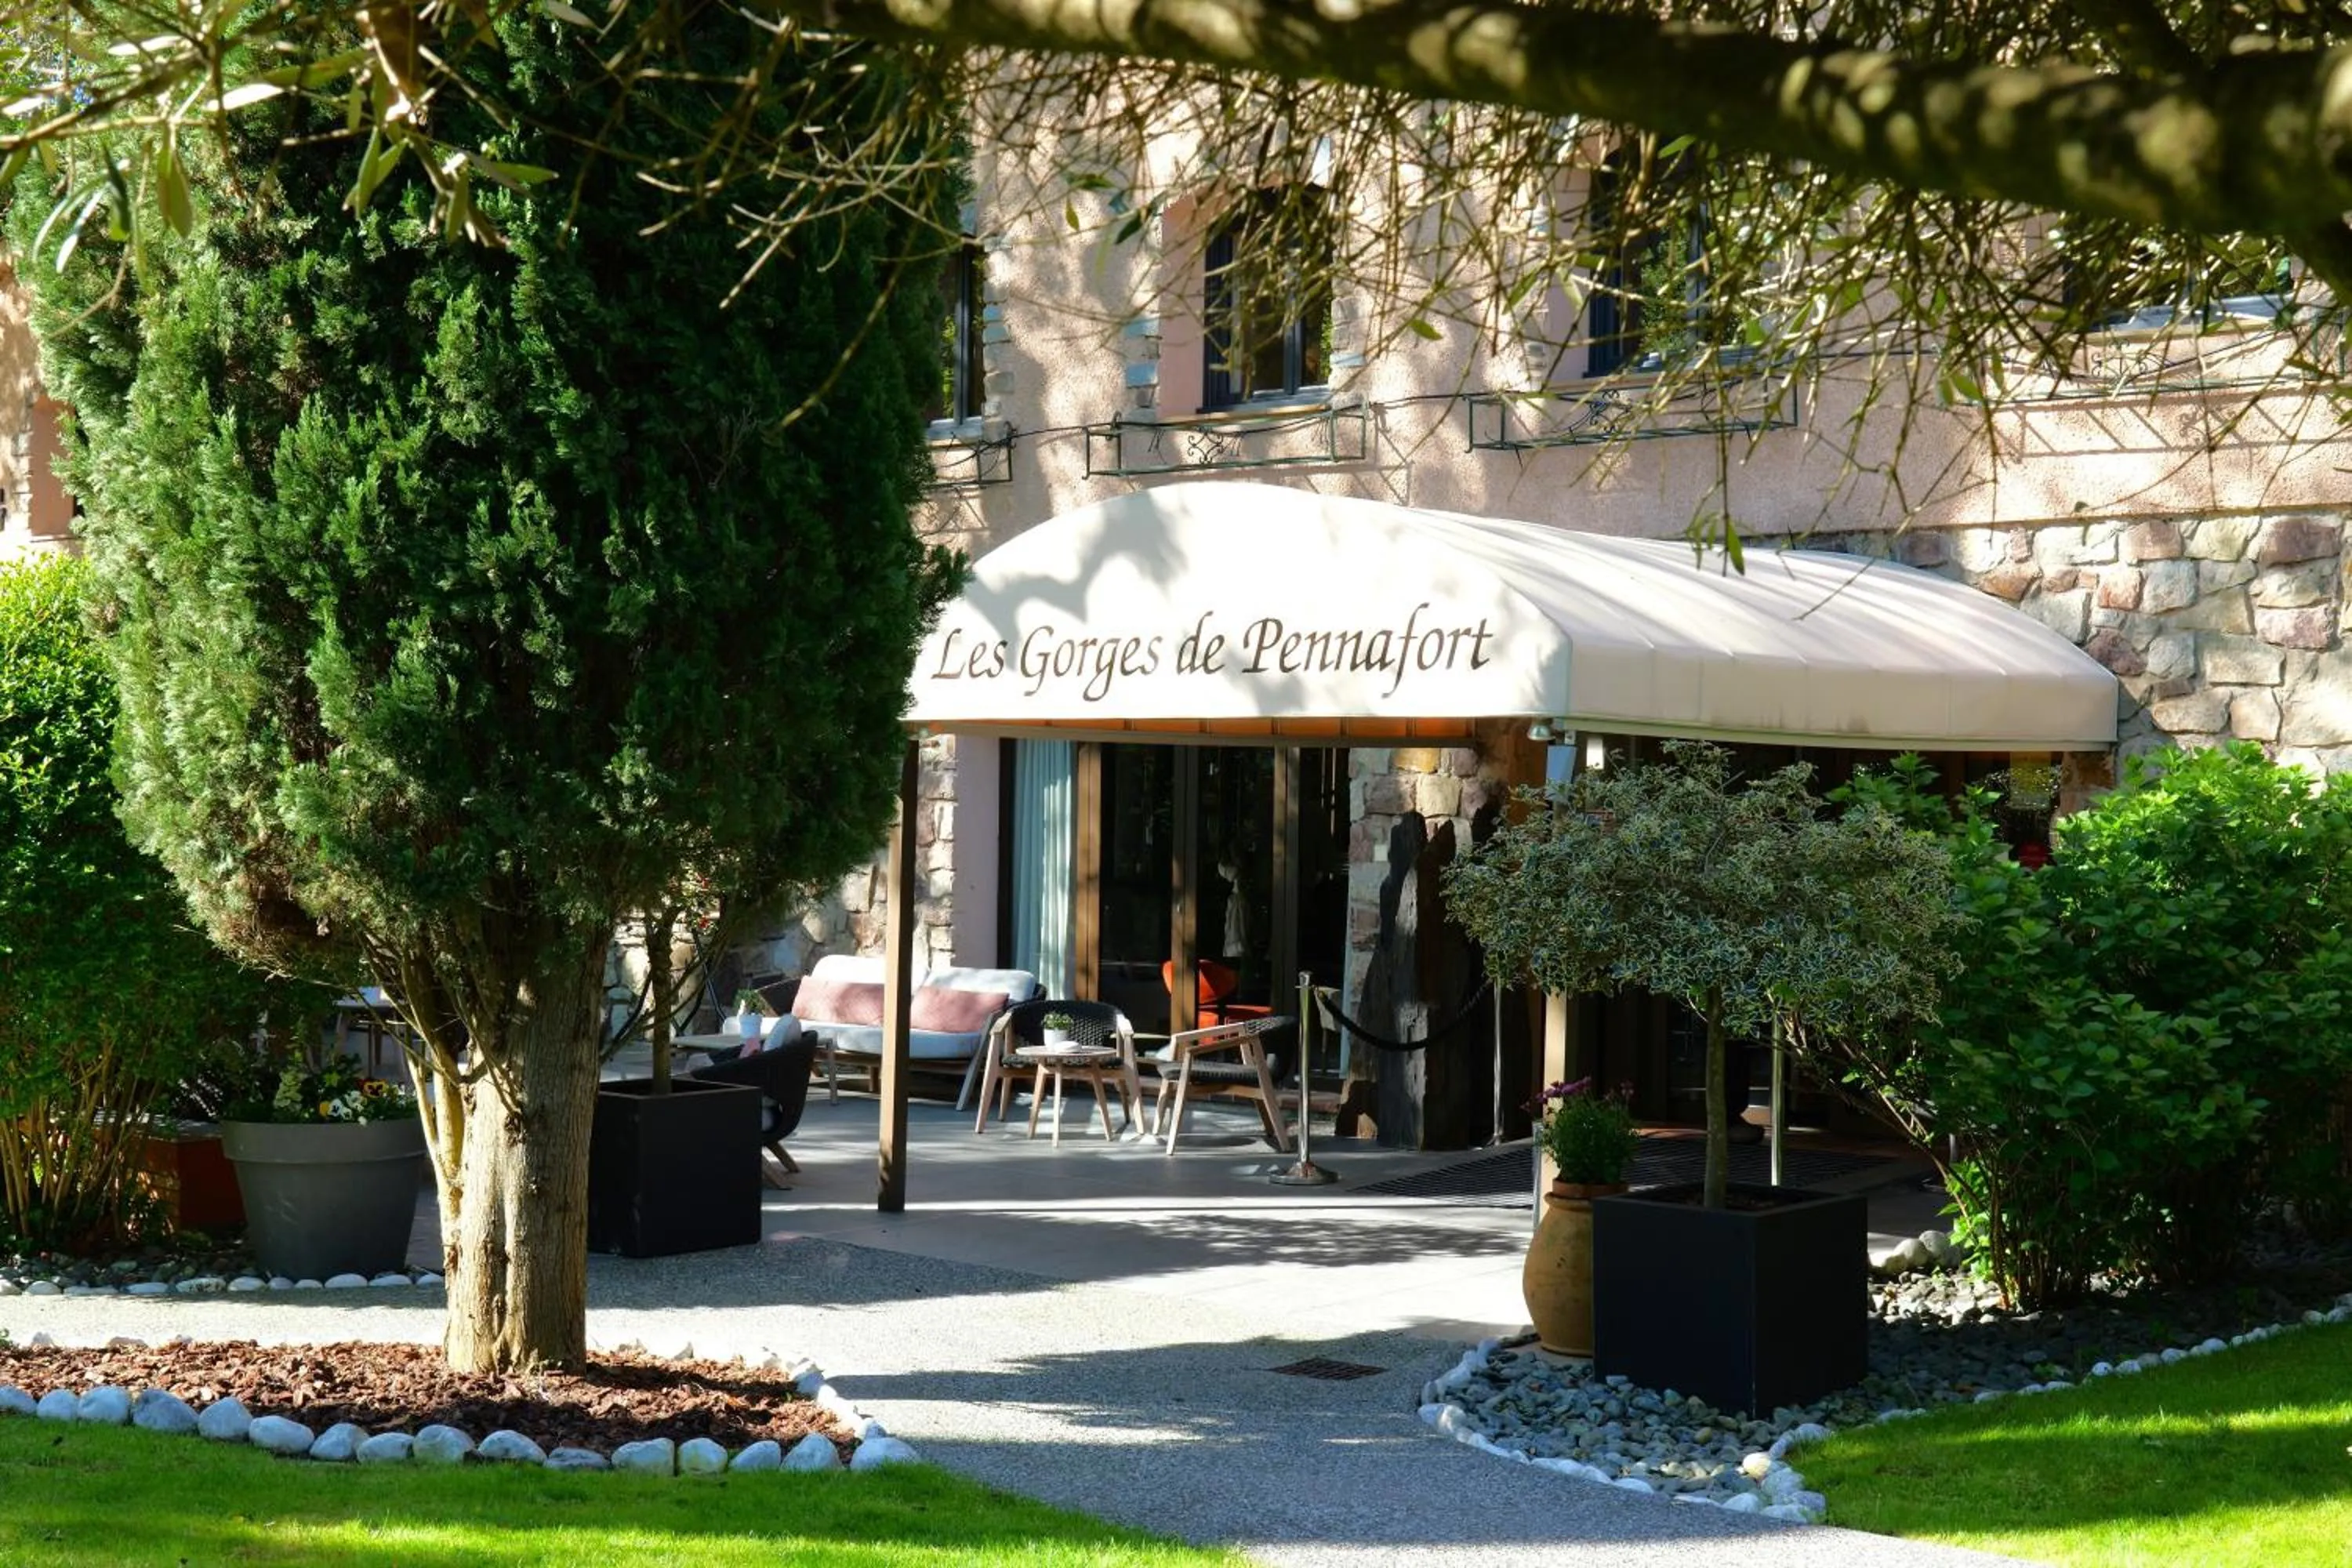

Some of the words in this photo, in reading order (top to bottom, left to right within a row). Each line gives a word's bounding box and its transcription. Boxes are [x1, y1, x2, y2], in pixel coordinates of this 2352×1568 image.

[931, 628, 1006, 680] Les
[1019, 624, 1160, 702] Gorges
[1174, 610, 1226, 676] de
[1242, 601, 1494, 699] Pennafort
